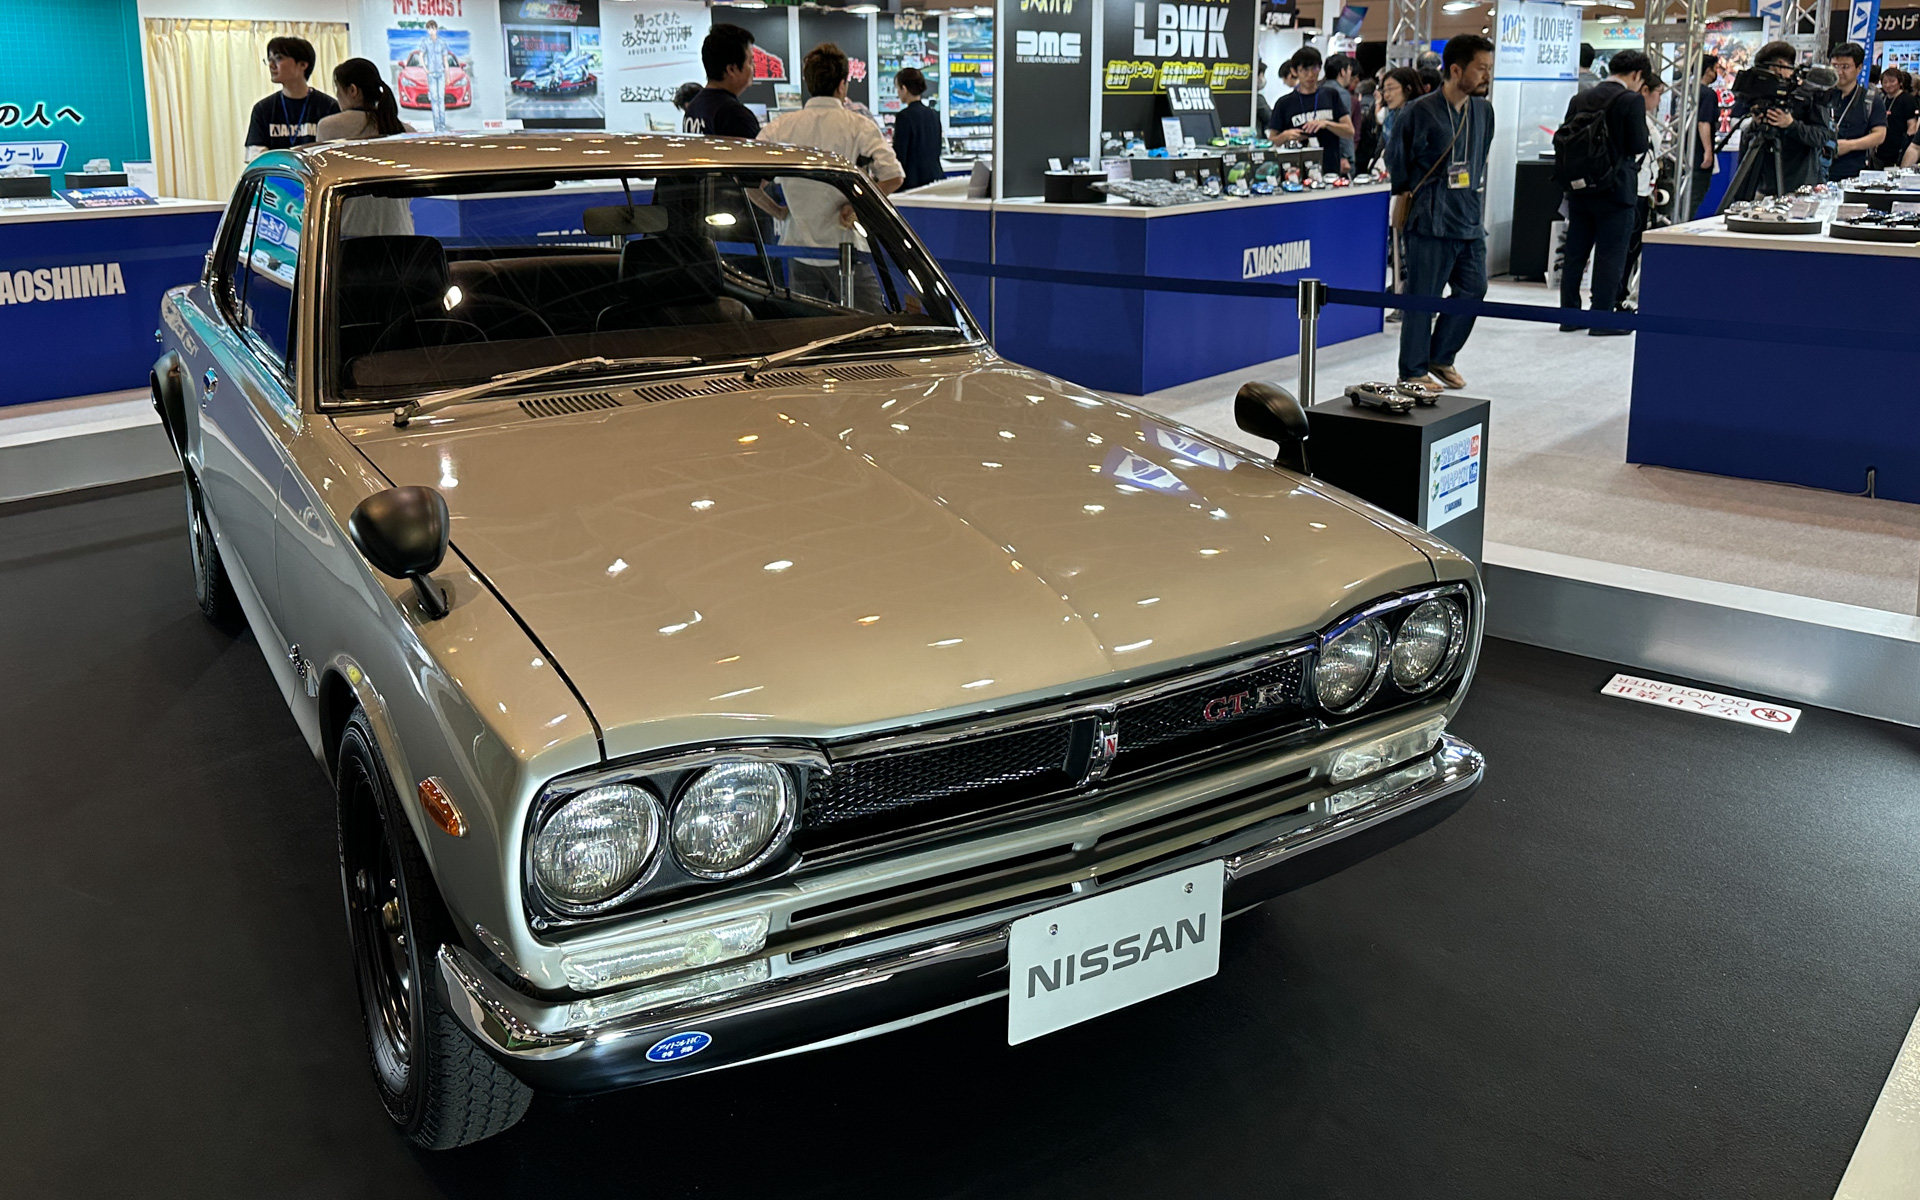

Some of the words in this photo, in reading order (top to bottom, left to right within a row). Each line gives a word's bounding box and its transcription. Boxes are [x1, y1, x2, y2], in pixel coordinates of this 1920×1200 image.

[634, 11, 681, 29] 帰ってきた
[1133, 2, 1229, 58] LBWK
[1539, 16, 1574, 43] 100周年
[622, 25, 693, 48] あぶない刑事
[1537, 44, 1568, 65] 記念展示
[1168, 87, 1215, 110] LBWK
[1257, 239, 1311, 276] AOSHIMA
[0, 262, 126, 305] AOSHIMA
[1617, 677, 1673, 692] ENTER
[1676, 689, 1716, 701] NOT
[1204, 682, 1284, 722] GT-R
[1720, 698, 1750, 708] DO
[1028, 913, 1206, 999] NISSAN
